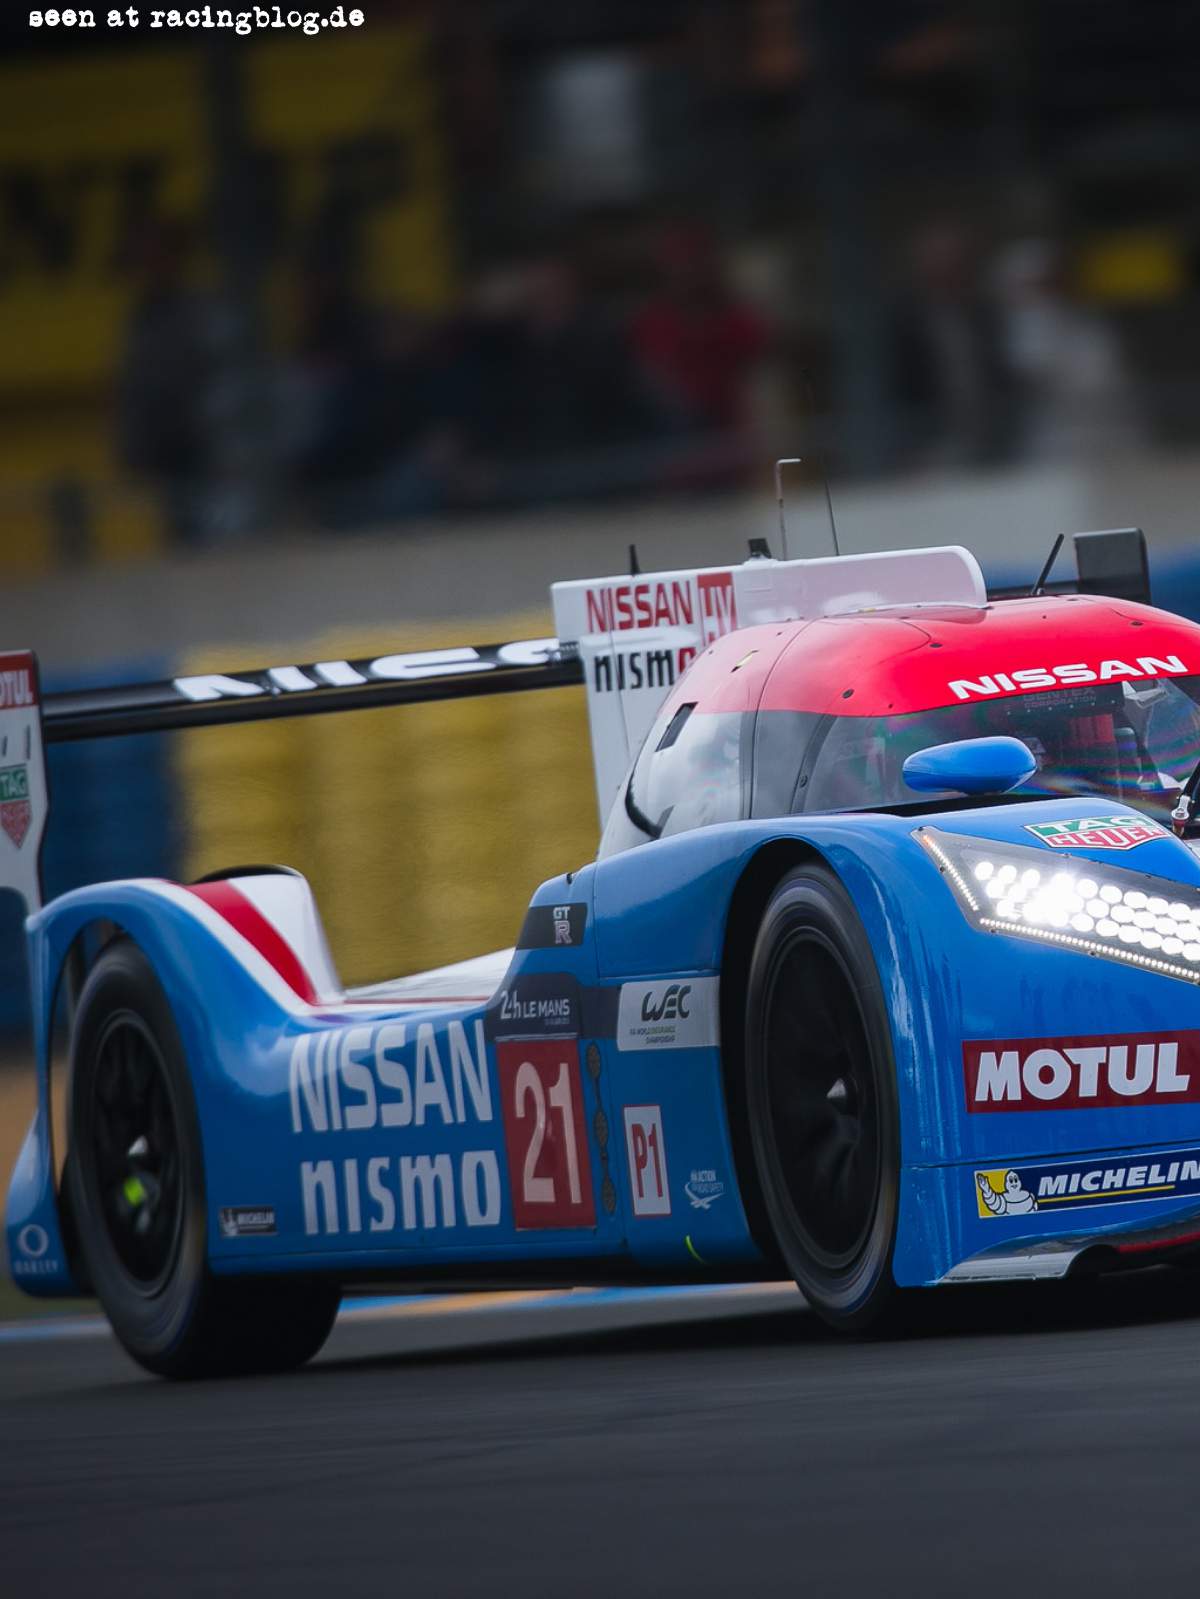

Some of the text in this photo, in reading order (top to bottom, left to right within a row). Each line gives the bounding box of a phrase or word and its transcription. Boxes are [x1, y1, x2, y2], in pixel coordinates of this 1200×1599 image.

[586, 581, 694, 633] NISSAN
[948, 655, 1188, 700] NISSAN
[1035, 815, 1152, 834] TAG
[553, 907, 571, 920] GT
[555, 920, 572, 944] R
[523, 1001, 537, 1018] LE
[538, 998, 570, 1017] MANS
[641, 984, 692, 1022] WEC
[290, 1019, 493, 1132] NISSAN
[975, 1042, 1190, 1101] MOTUL
[515, 1061, 582, 1204] 21
[631, 1123, 663, 1198] P1
[301, 1150, 500, 1236] nismo
